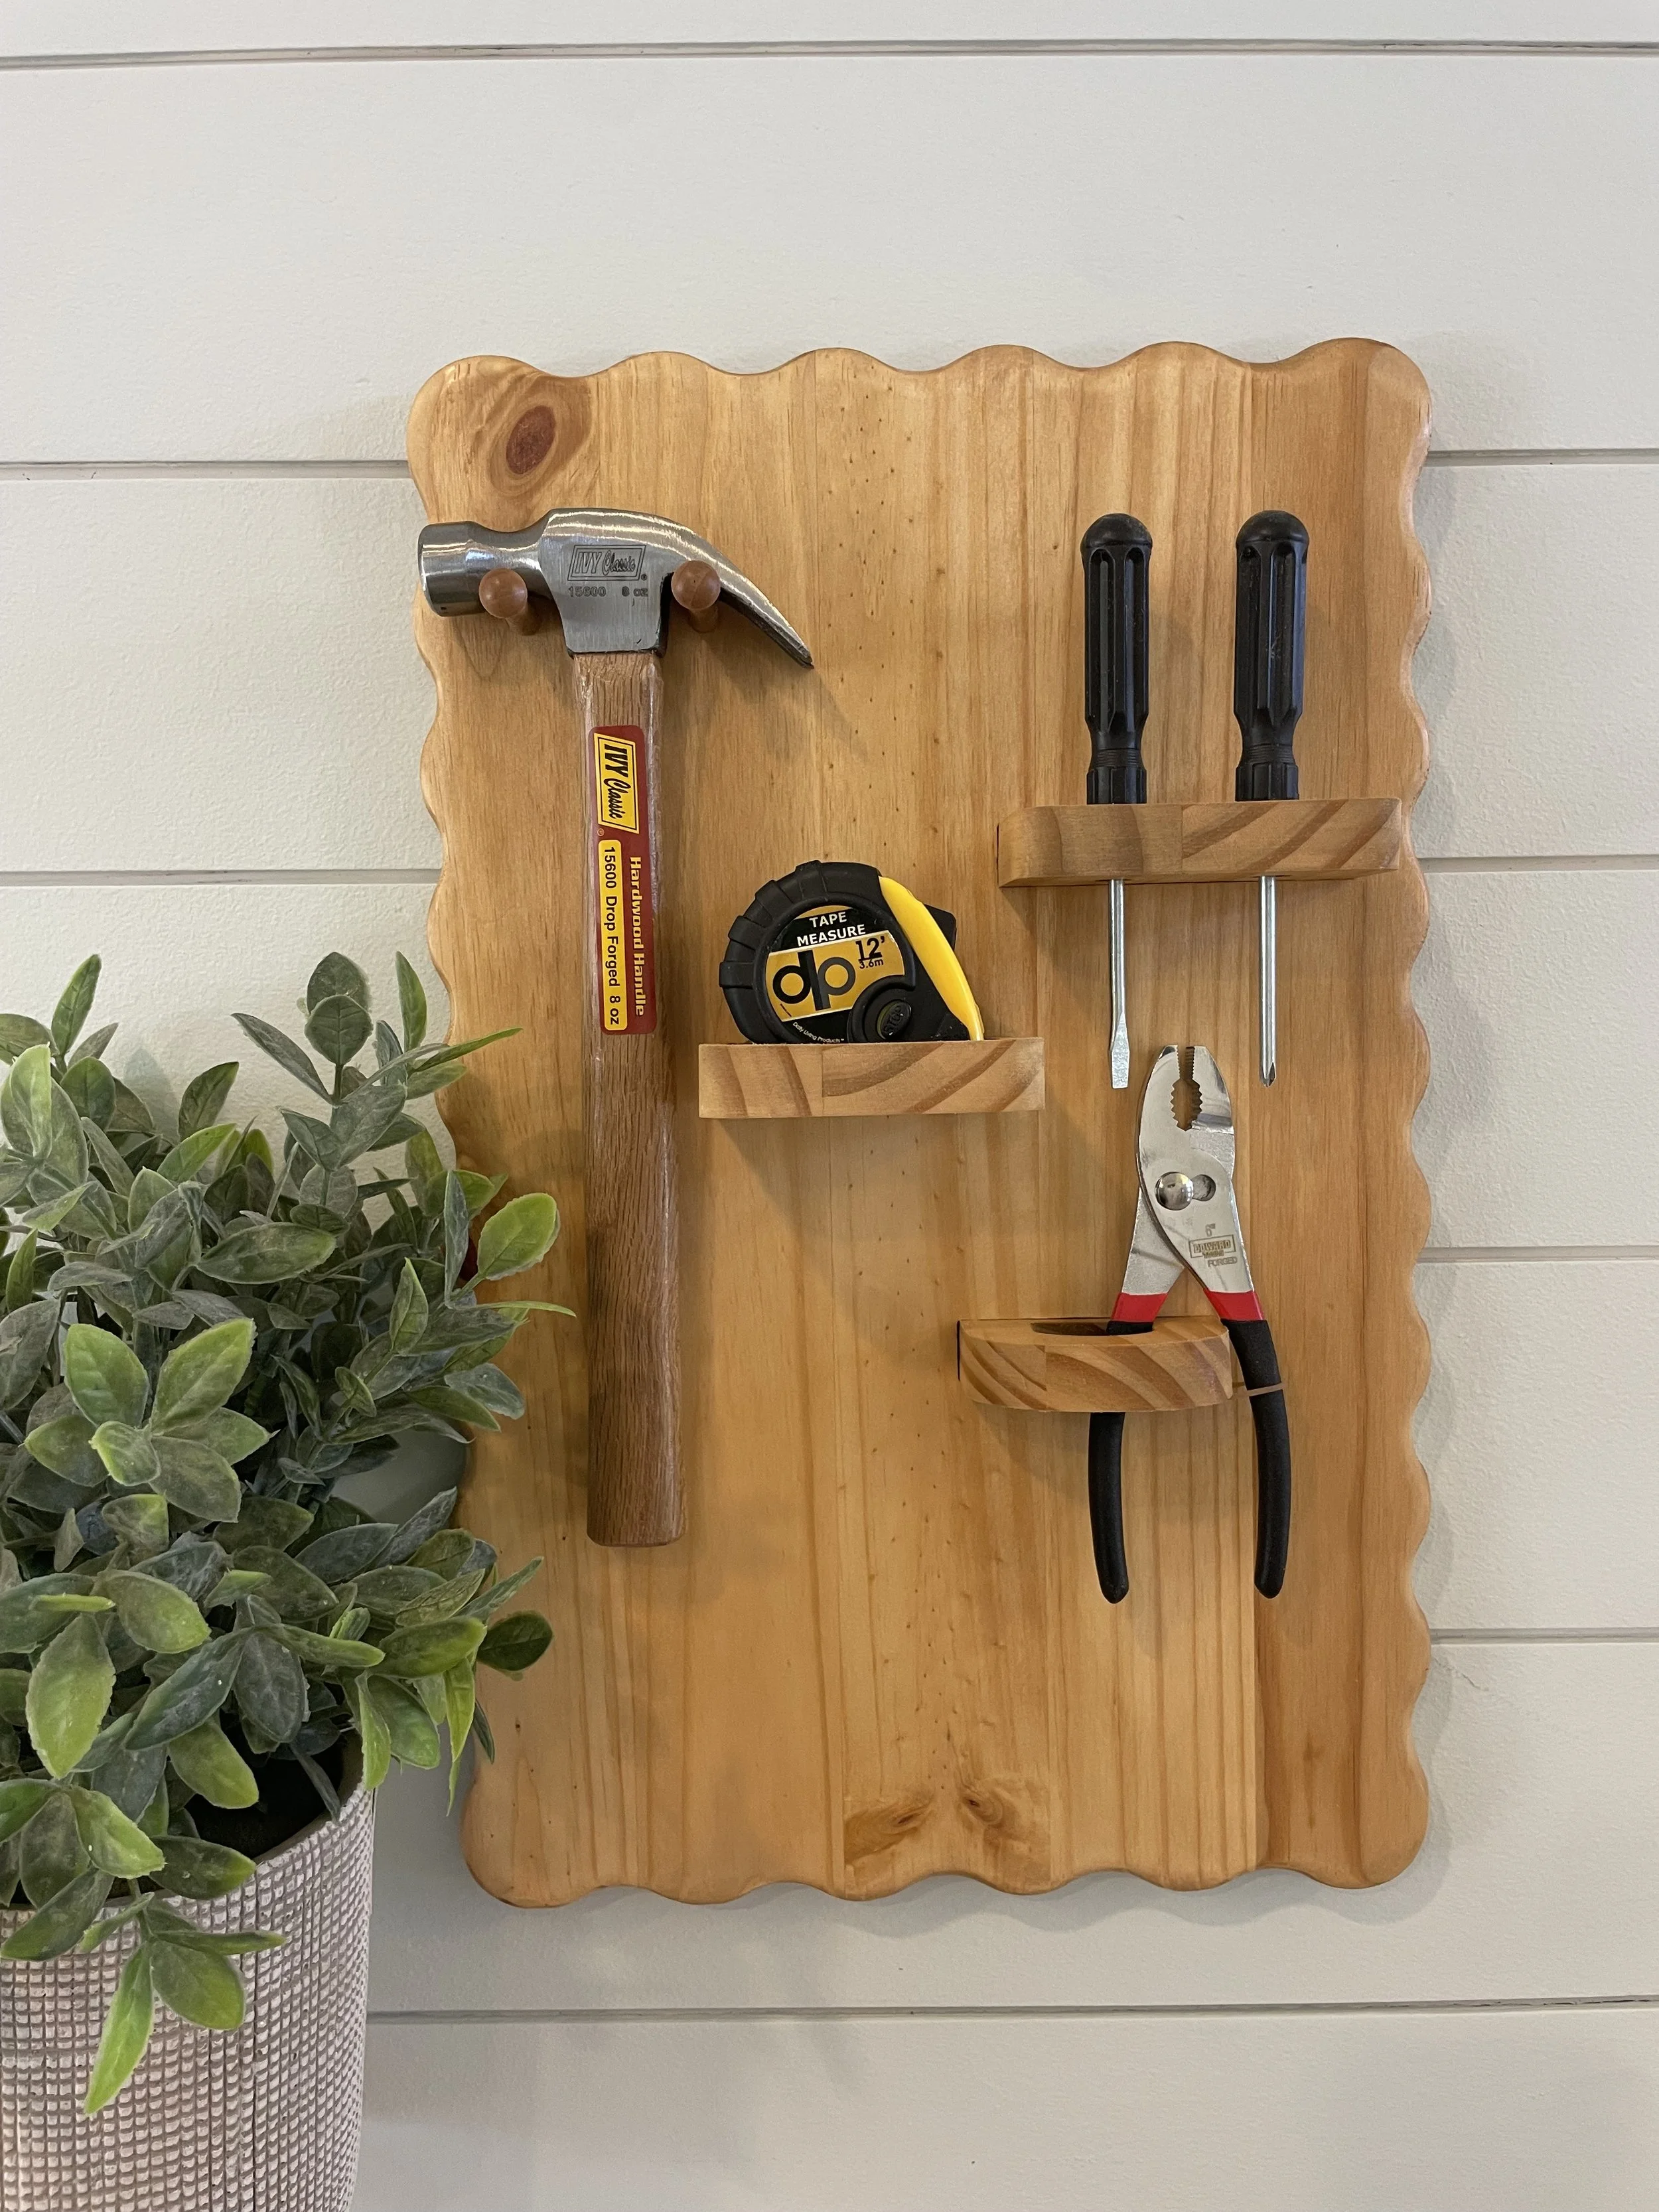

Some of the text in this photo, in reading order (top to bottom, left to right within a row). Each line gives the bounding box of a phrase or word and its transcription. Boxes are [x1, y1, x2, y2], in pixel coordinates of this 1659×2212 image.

[575, 550, 636, 576] IVY Classic
[568, 585, 607, 597] 15600
[633, 588, 648, 597] oz
[603, 743, 632, 820] IVY Classic
[809, 911, 847, 928] TAPE
[604, 846, 621, 1025] 15600 Drop Forged 8 oz
[630, 857, 646, 1017] Hardwood Handle
[797, 924, 866, 947] MEASURE
[859, 958, 884, 970] 3.6m
[772, 949, 856, 1011] dp
[792, 1021, 804, 1033] Daily
[803, 1029, 817, 1041] Living
